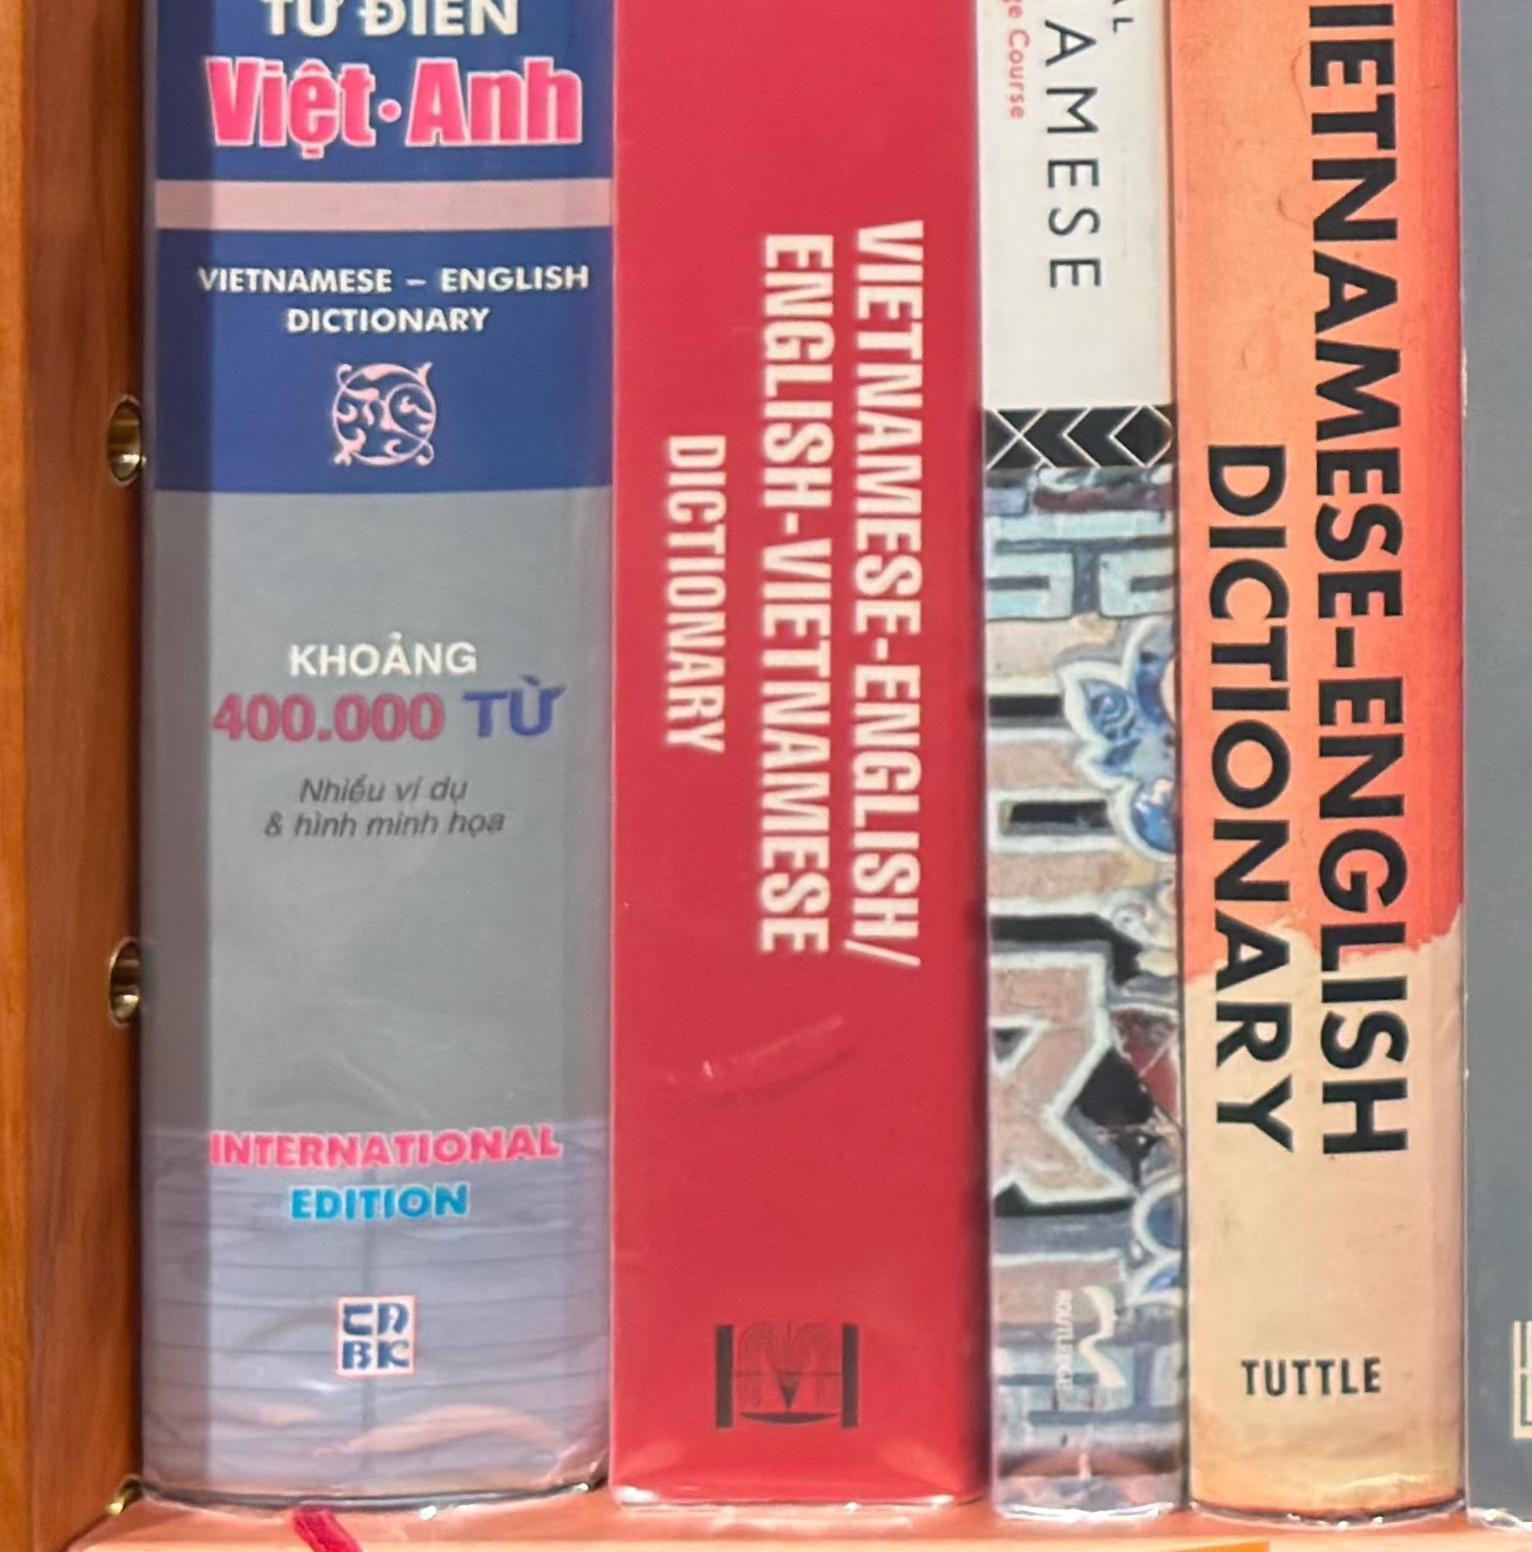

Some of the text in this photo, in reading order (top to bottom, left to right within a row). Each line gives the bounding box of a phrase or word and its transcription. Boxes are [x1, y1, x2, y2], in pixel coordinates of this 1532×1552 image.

[1007, 27, 1030, 120] Course
[199, 267, 393, 294] VIETNAMESE
[440, 264, 590, 294] ENGLISH
[286, 308, 490, 334] DICTIONARY
[665, 435, 728, 753] DICTIONARY
[760, 233, 835, 954] ENGLISH-VIETNAMESE
[844, 219, 925, 968] VIETNAMESE-ENGLISH/
[288, 631, 478, 677] KHOẢNG
[211, 674, 568, 742] 400.000 TỪ
[1207, 443, 1294, 1154] DICTIONARY
[264, 811, 284, 838] &
[366, 810, 439, 837] minh
[207, 1124, 564, 1171] INTERNATIONAL
[288, 1181, 471, 1223] EDITION
[1240, 1356, 1382, 1397] TUTTLE
